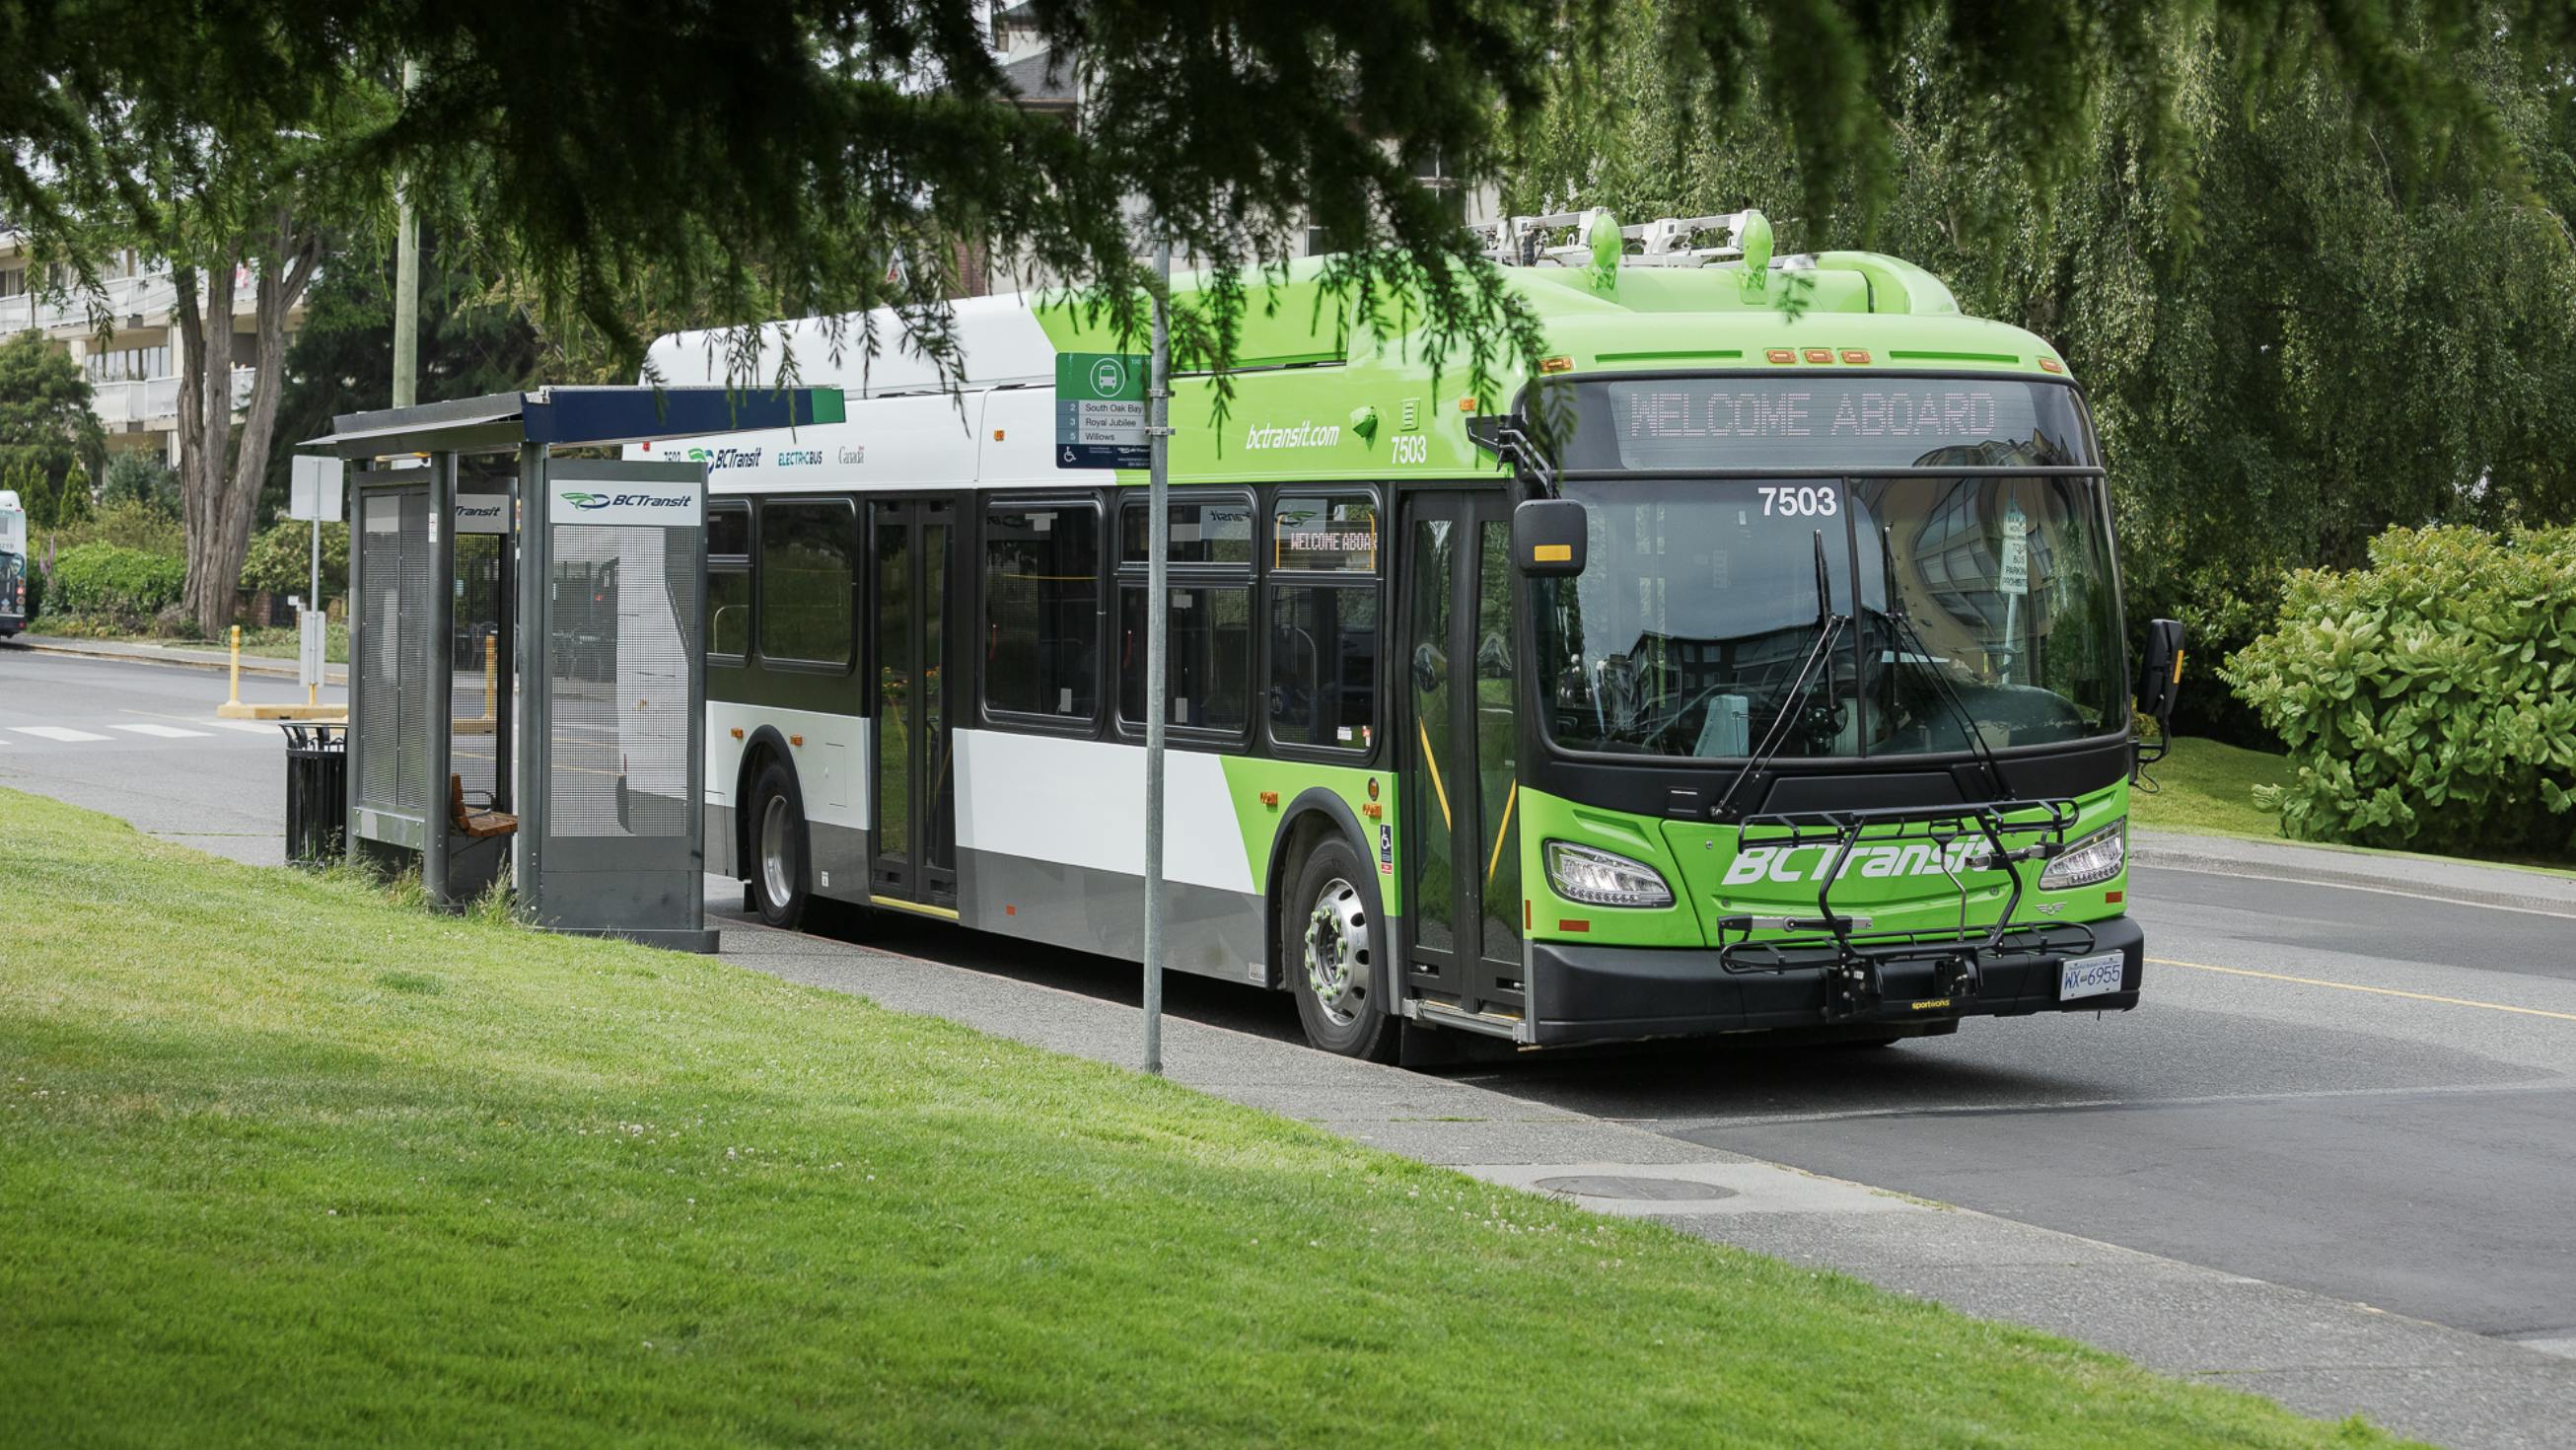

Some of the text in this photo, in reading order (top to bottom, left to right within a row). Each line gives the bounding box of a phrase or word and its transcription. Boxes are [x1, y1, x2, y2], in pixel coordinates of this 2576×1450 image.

[1085, 403, 1109, 412] South
[1110, 403, 1126, 412] Oak
[1128, 404, 1143, 415] Bay
[1631, 393, 1996, 436] WELCOME ABOARD
[1085, 418, 1107, 429] Royal
[1109, 418, 1137, 427] Jubilee
[1085, 432, 1115, 442] Willows
[1246, 420, 1340, 450] bctransit.com
[715, 447, 762, 471] BCTransit
[838, 445, 865, 466] Canada
[1391, 435, 1427, 465] 7503
[611, 494, 692, 508] BCTransit
[1757, 486, 1837, 517] 7503
[1290, 533, 1339, 551] WELCOME
[1721, 834, 1994, 886] BCTransit
